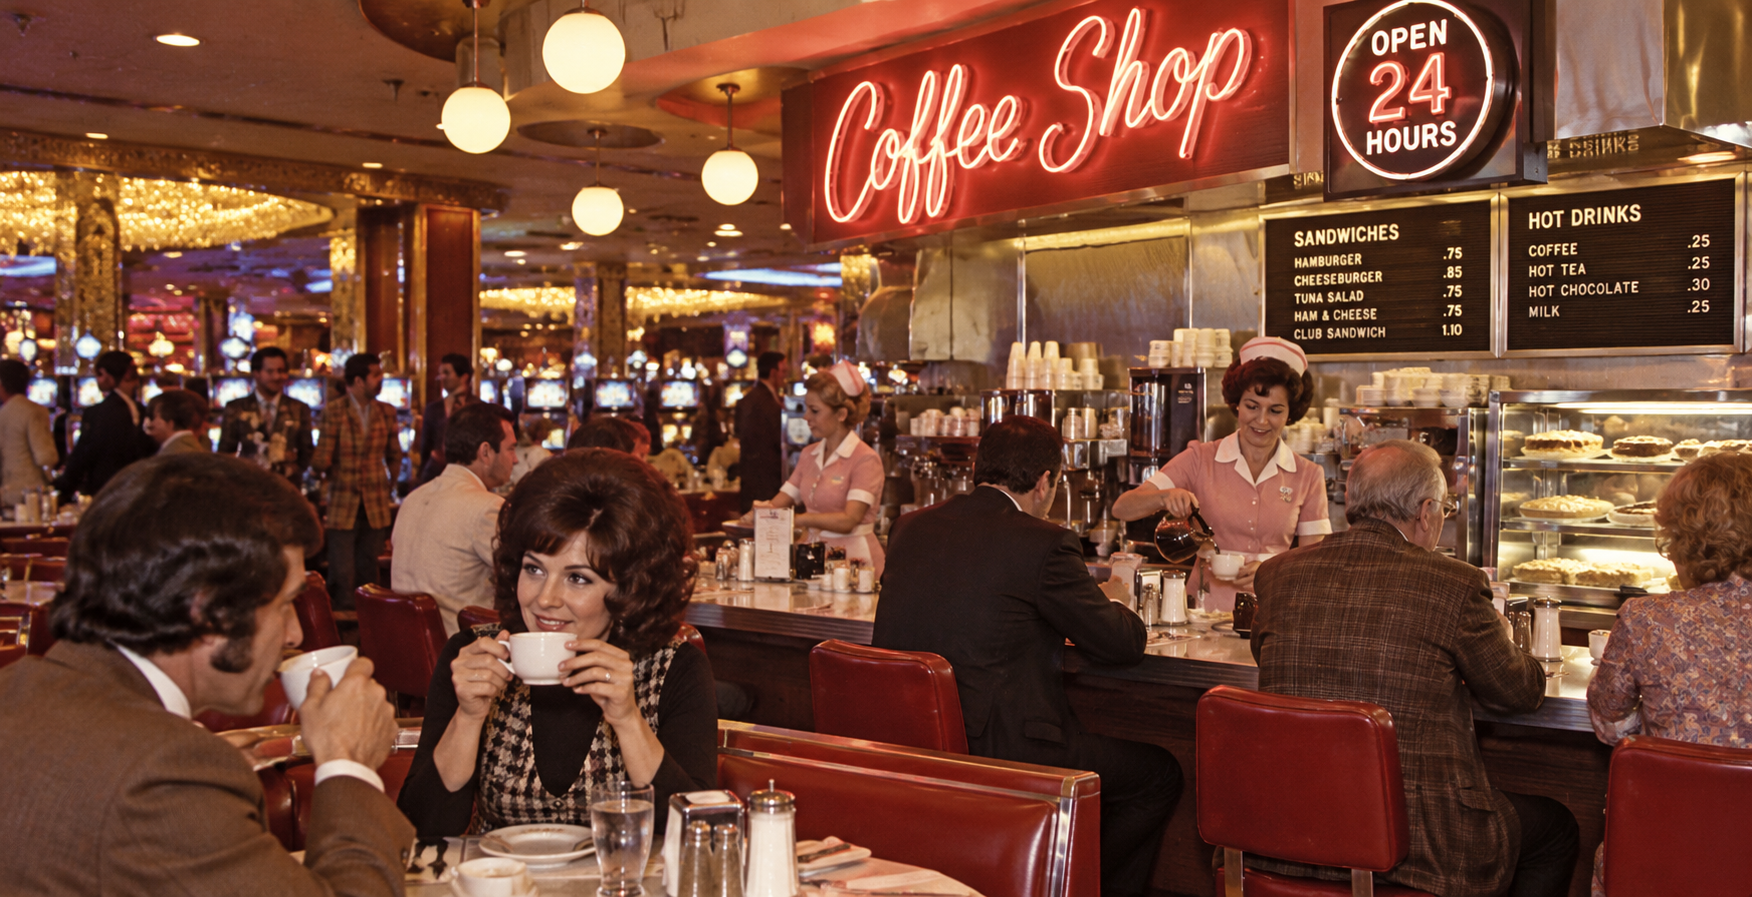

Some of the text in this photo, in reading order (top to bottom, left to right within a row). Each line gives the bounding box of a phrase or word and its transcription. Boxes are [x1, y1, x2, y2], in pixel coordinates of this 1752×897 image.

[1371, 18, 1448, 57] OPEN
[1368, 52, 1452, 124] 24
[824, 6, 1251, 225] Coffee Shop
[1366, 120, 1458, 156] HOURS
[1528, 203, 1642, 230] HOT DRINKS
[1294, 223, 1400, 248] SANDWICHES
[1528, 234, 1710, 257] COFFEE .25
[1294, 246, 1463, 269] HAMBURGER .75
[1528, 255, 1710, 278] HOT TEA .25
[1294, 265, 1463, 287] CHEESEBURGER .85
[1528, 277, 1710, 298] HOT CHOCOLATE .30
[1294, 285, 1463, 305] TUNA SALAD .75
[1294, 304, 1463, 322] HAM & CHEESE .75
[1528, 299, 1710, 318] MILK .25
[1293, 323, 1463, 340] CLUB SANDWICH 1.10
